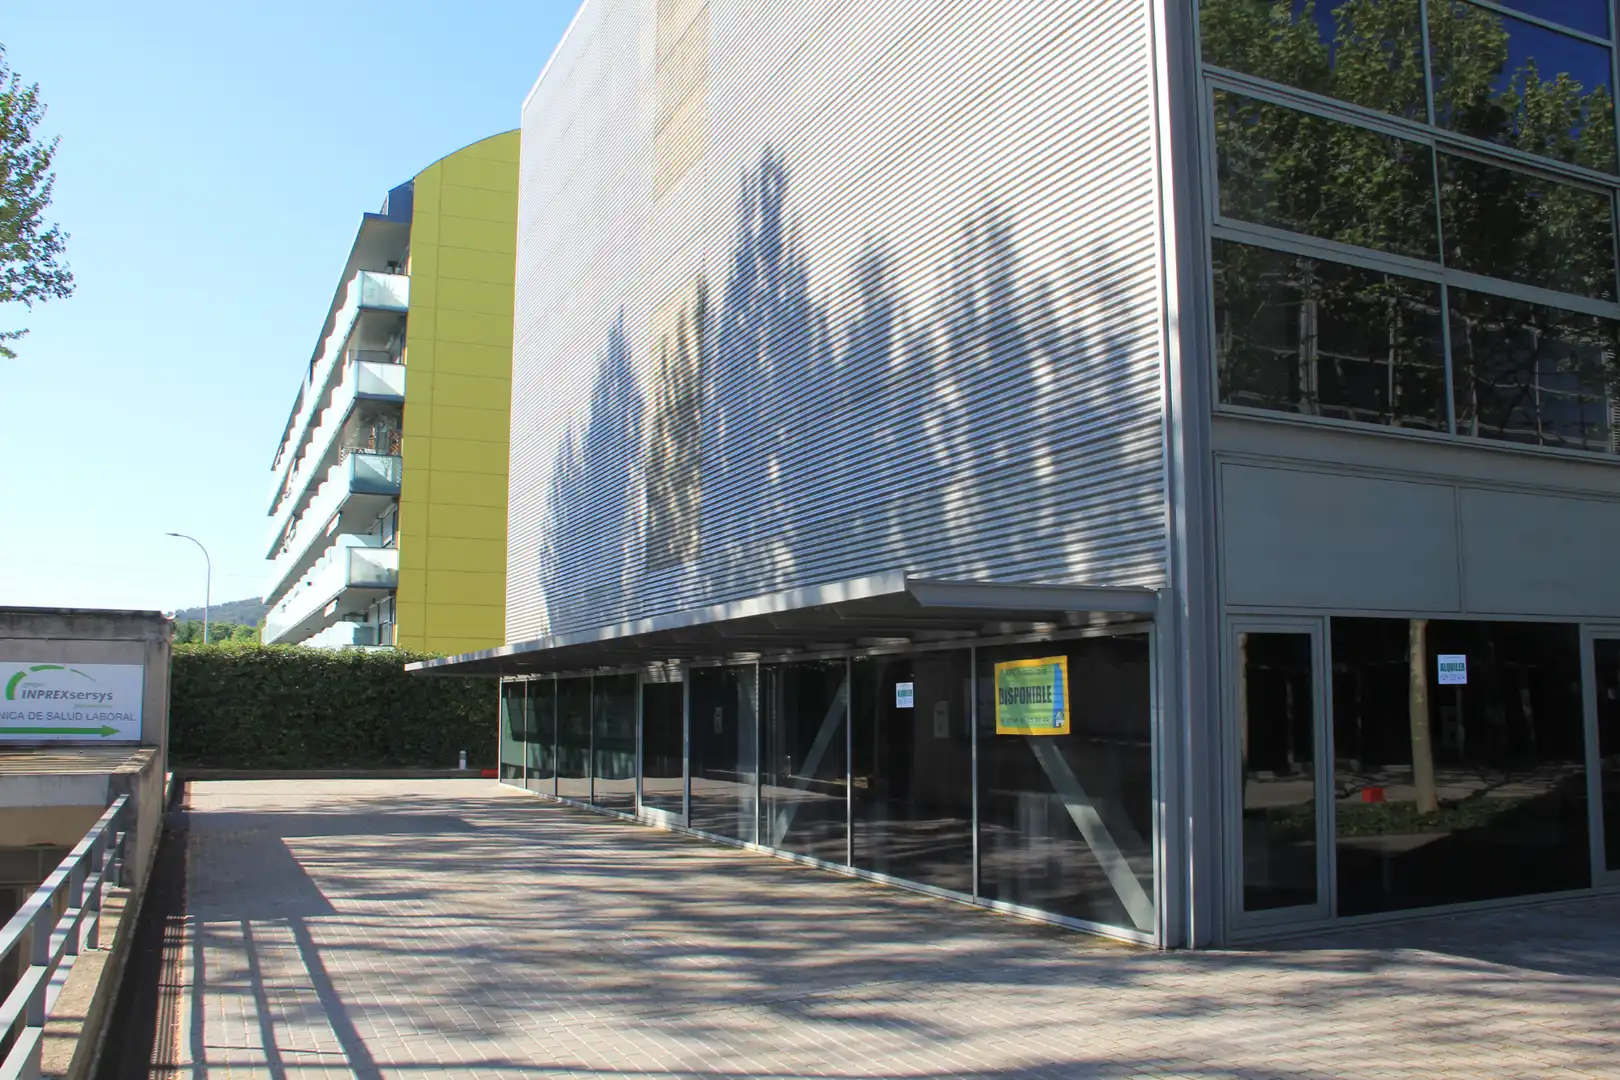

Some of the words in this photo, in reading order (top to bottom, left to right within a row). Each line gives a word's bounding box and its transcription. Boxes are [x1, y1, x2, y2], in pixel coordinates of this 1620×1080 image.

[22, 689, 113, 703] INPREXsersys
[999, 685, 1052, 705] DISPONIBLE
[28, 711, 43, 720] DE
[46, 711, 83, 721] SALUD
[86, 712, 137, 721] LABORAL
